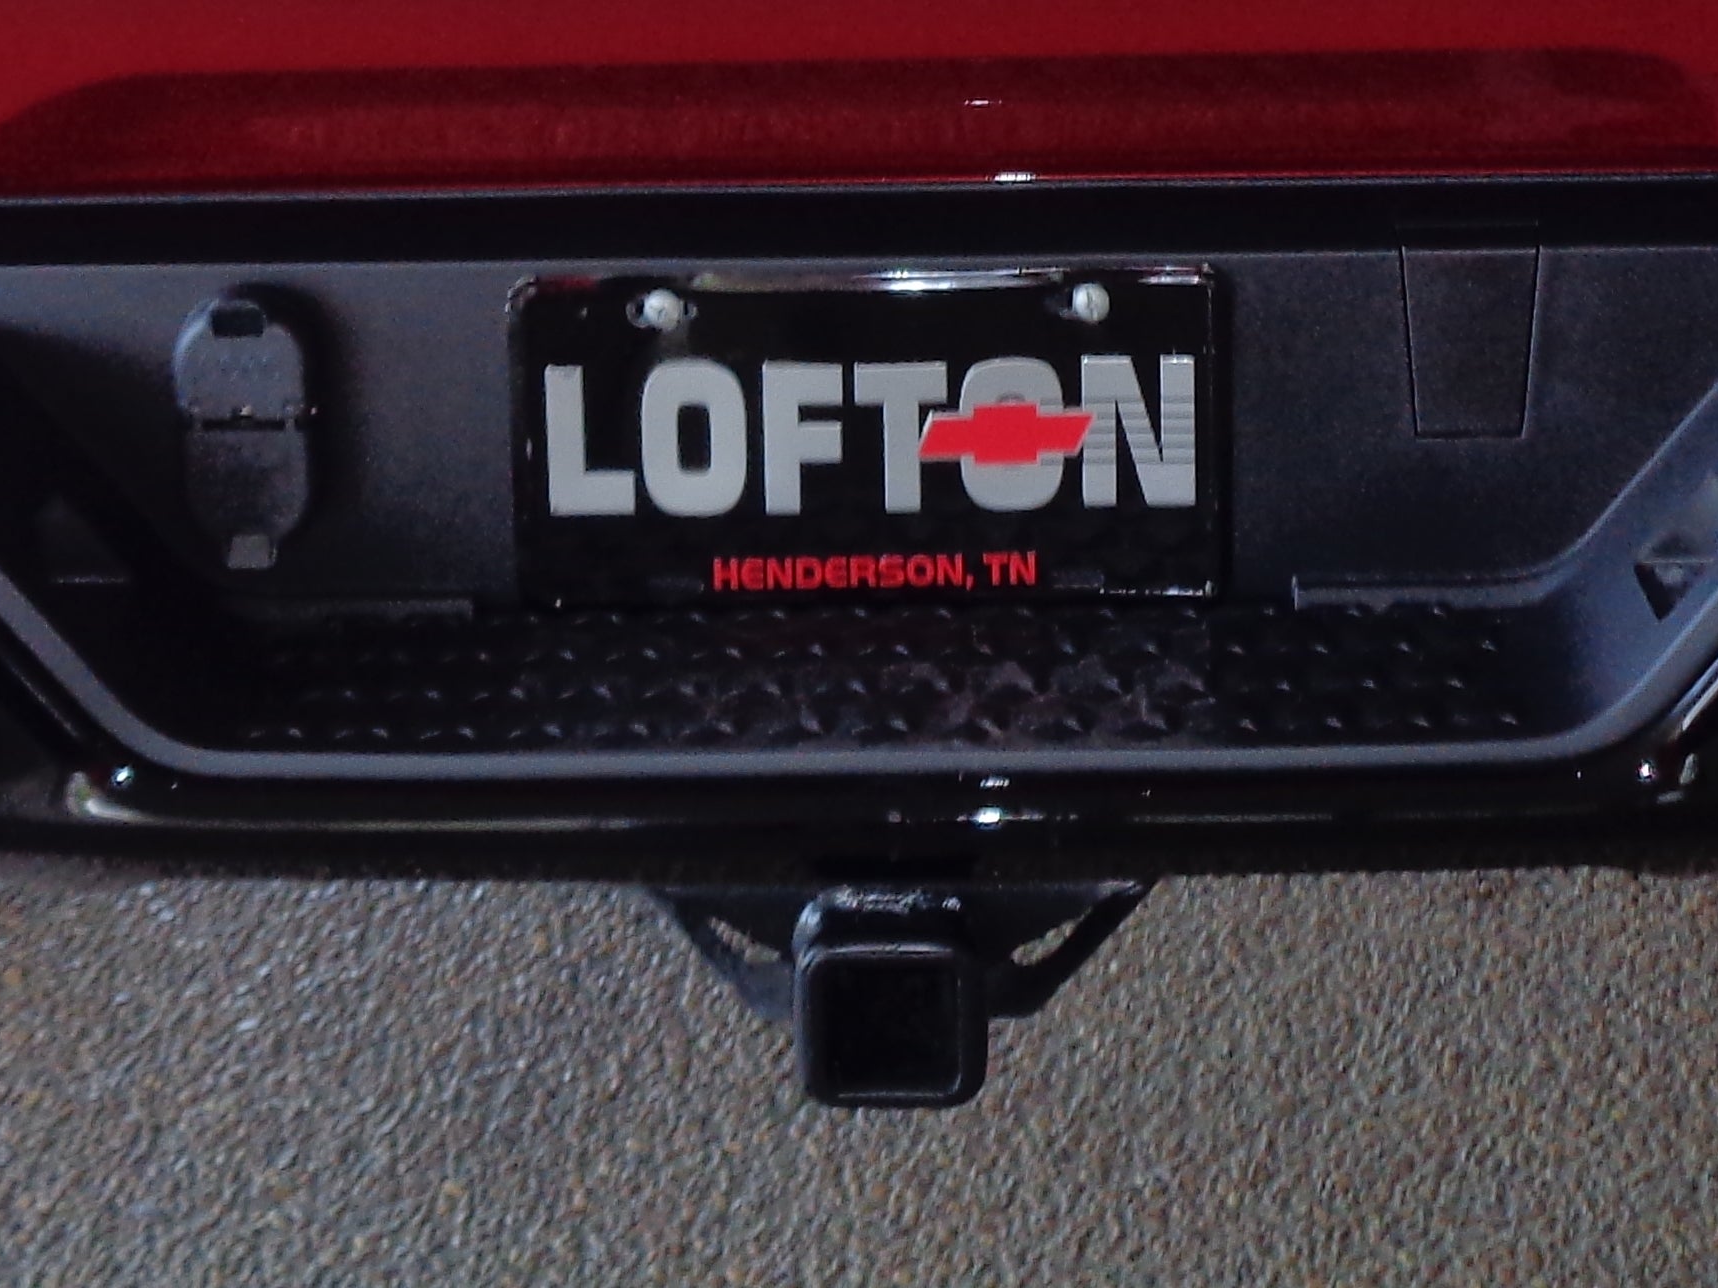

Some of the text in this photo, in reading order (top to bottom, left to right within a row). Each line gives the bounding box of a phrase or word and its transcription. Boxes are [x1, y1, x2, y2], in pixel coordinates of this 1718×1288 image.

[544, 354, 1196, 517] LOFTON
[712, 552, 1037, 592] HENDERSON, TN
